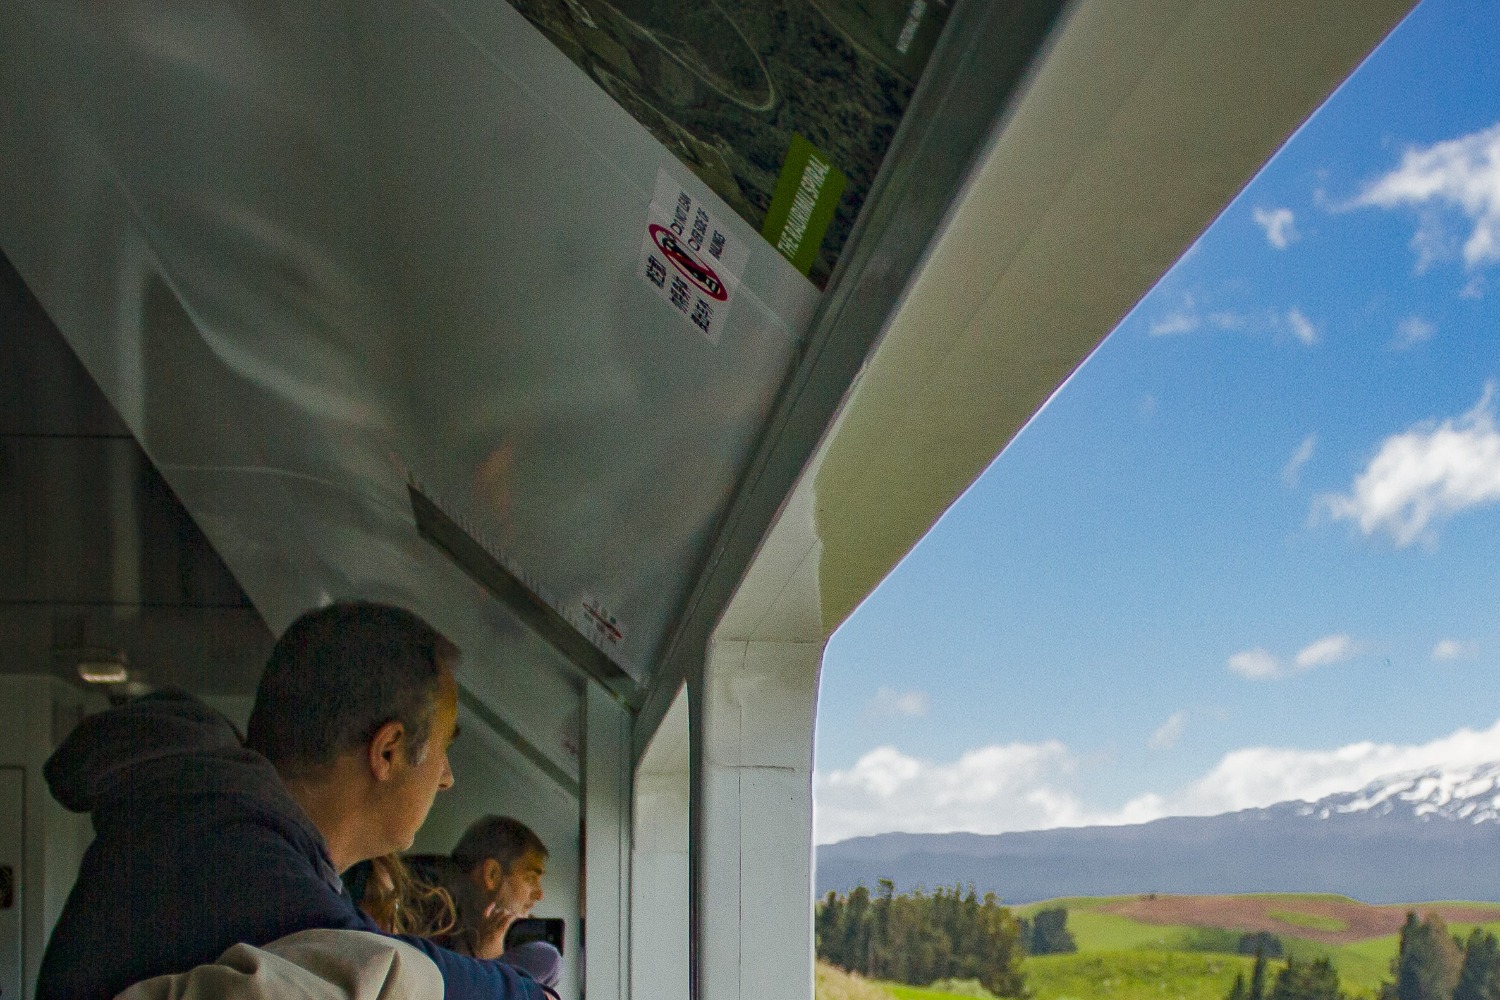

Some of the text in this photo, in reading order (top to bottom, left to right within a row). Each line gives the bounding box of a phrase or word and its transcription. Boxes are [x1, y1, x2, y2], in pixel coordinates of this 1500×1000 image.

[669, 190, 691, 237] DO NOT LEAN
[776, 151, 829, 260] THE RAURIMU SPIRAL
[687, 207, 709, 253] OVER SIDE OF
[708, 229, 726, 261] RAILINGS
